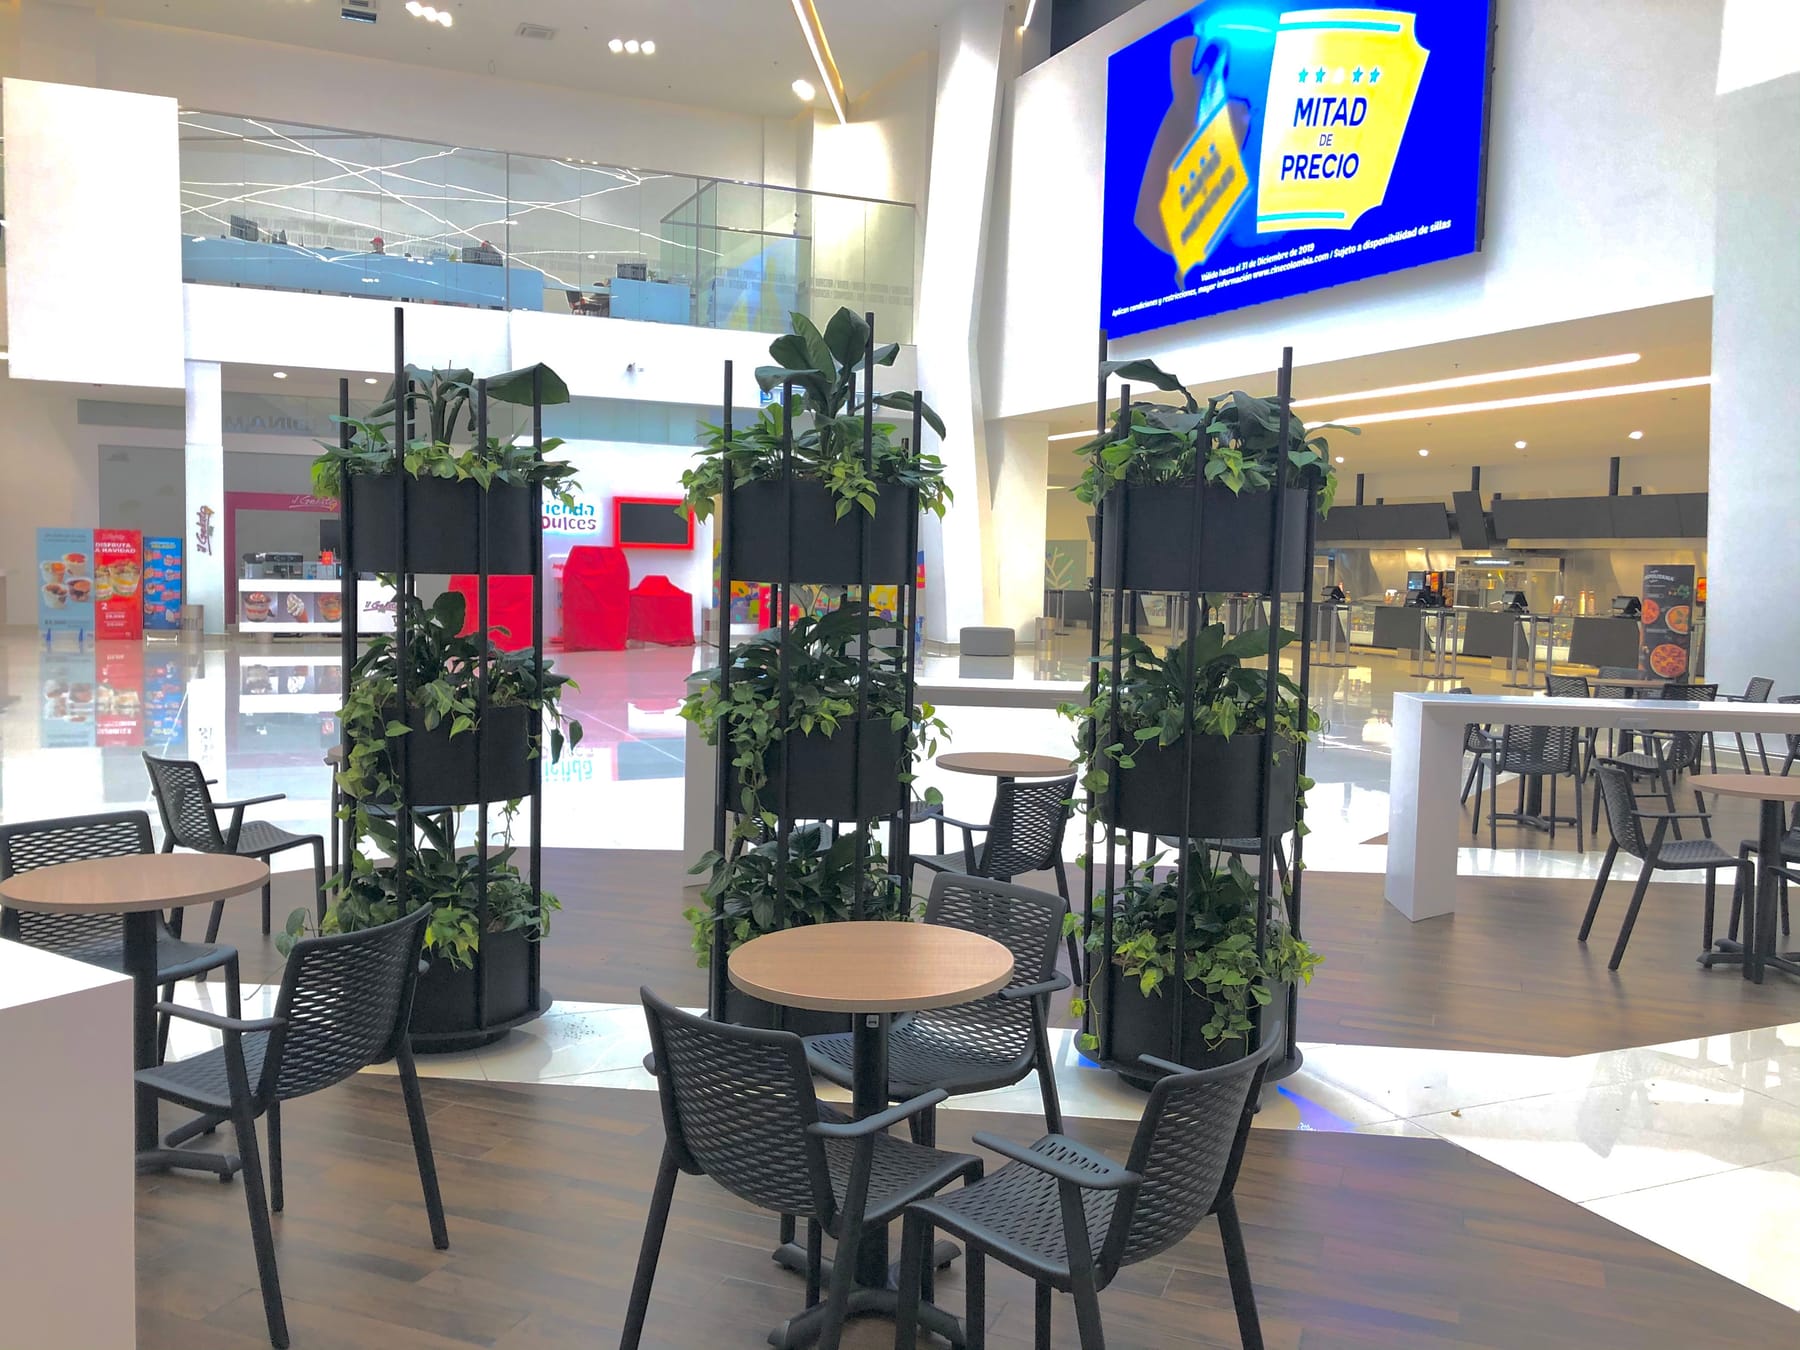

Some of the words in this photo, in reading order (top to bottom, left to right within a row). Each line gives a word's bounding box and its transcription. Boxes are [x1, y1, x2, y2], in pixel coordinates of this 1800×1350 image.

[1293, 97, 1367, 127] MITAD
[1319, 133, 1334, 147] DE
[1281, 153, 1359, 181] PRECIO
[1129, 298, 1158, 313] condiciones
[1216, 272, 1253, 289] información
[1252, 252, 1330, 279] www.cinecolombia.com
[1333, 245, 1356, 259] Sujeto
[1357, 244, 1362, 252] a
[1362, 227, 1418, 250] disponibilidad
[1418, 225, 1428, 235] de
[1429, 219, 1452, 233] sillas
[1242, 261, 1248, 270] 31
[1249, 259, 1256, 268] de
[1256, 251, 1289, 267] Diciembre
[1290, 248, 1298, 257] de
[1298, 242, 1315, 255] 2019
[545, 501, 595, 516] ienda
